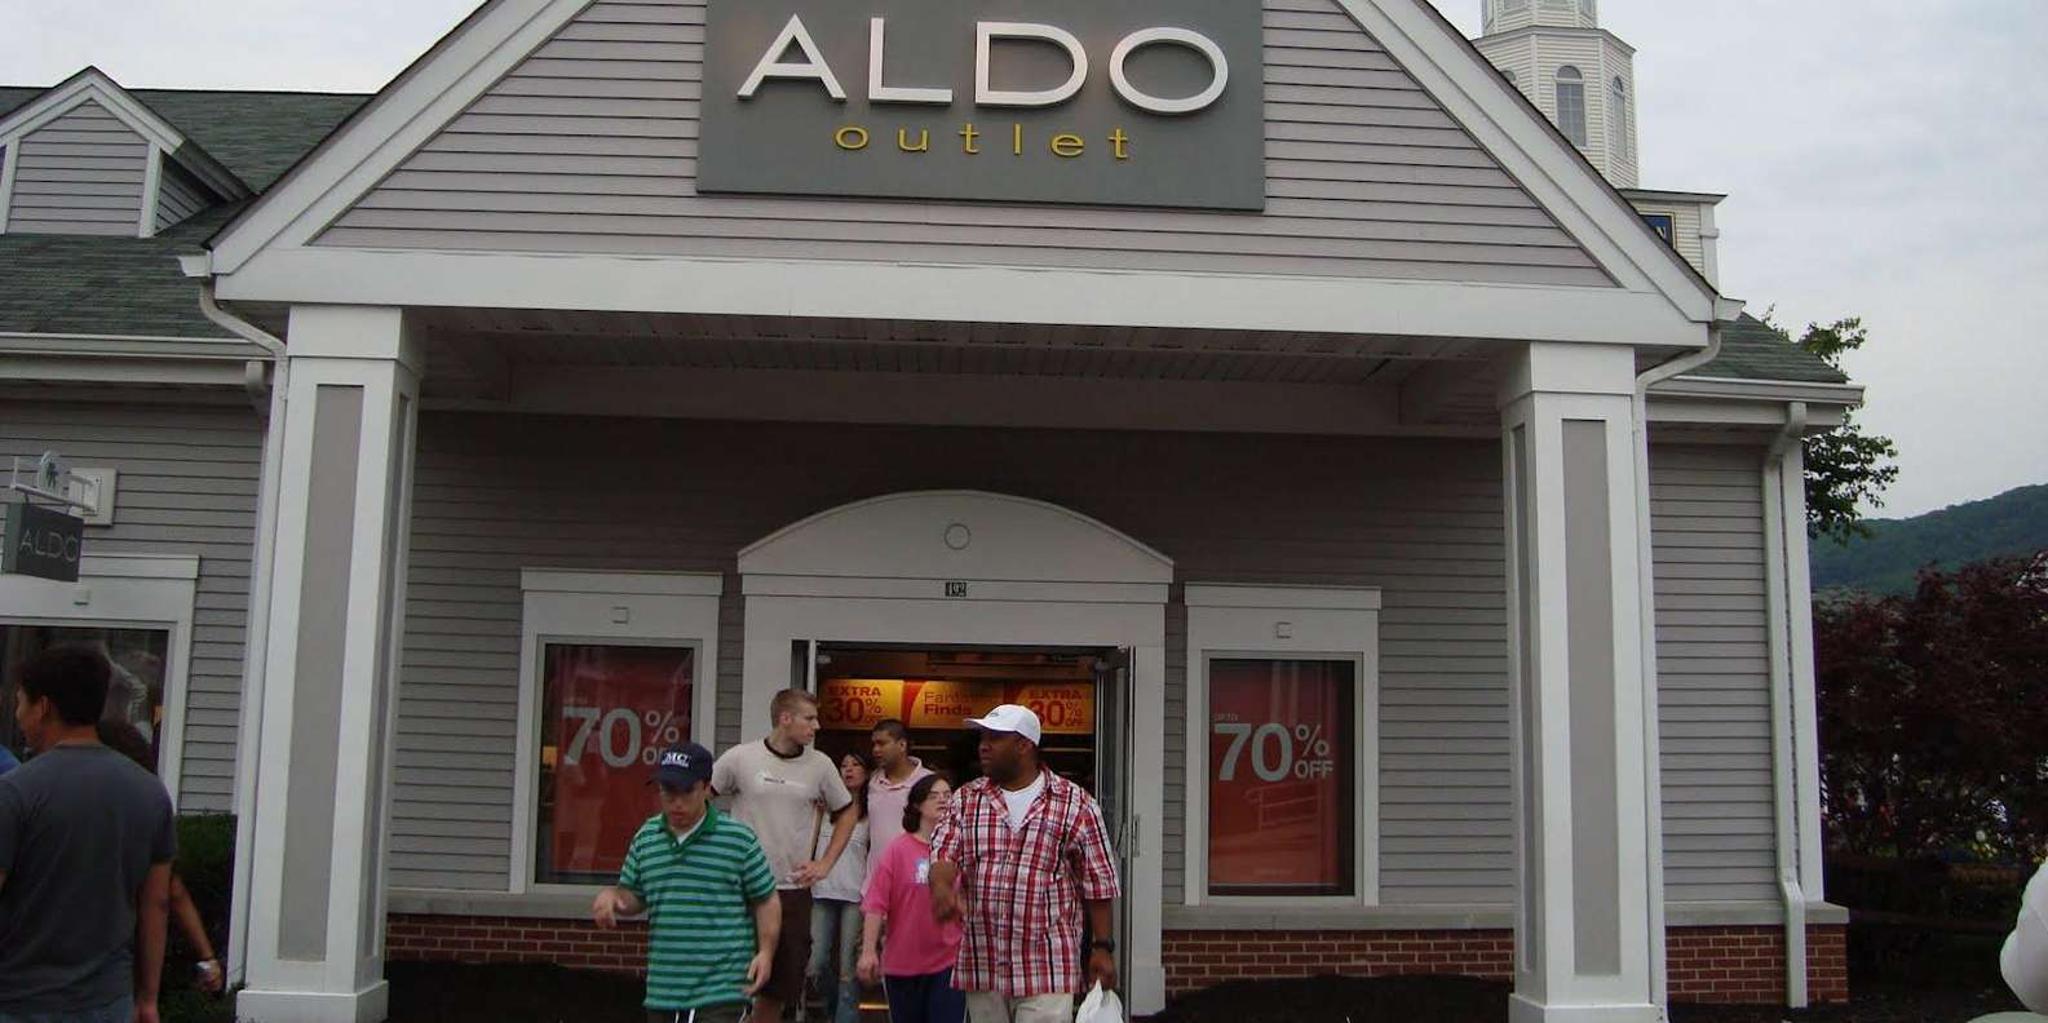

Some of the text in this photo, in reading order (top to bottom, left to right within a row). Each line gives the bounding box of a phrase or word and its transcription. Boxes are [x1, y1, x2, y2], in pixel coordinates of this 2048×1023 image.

[737, 13, 1229, 116] ALDO
[834, 122, 1130, 159] outlet
[19, 528, 79, 562] ALDO
[827, 685, 882, 697] EXTRA
[1029, 689, 1082, 699] EXTRA
[924, 703, 972, 716] Finds
[1294, 760, 1334, 780] OFF
